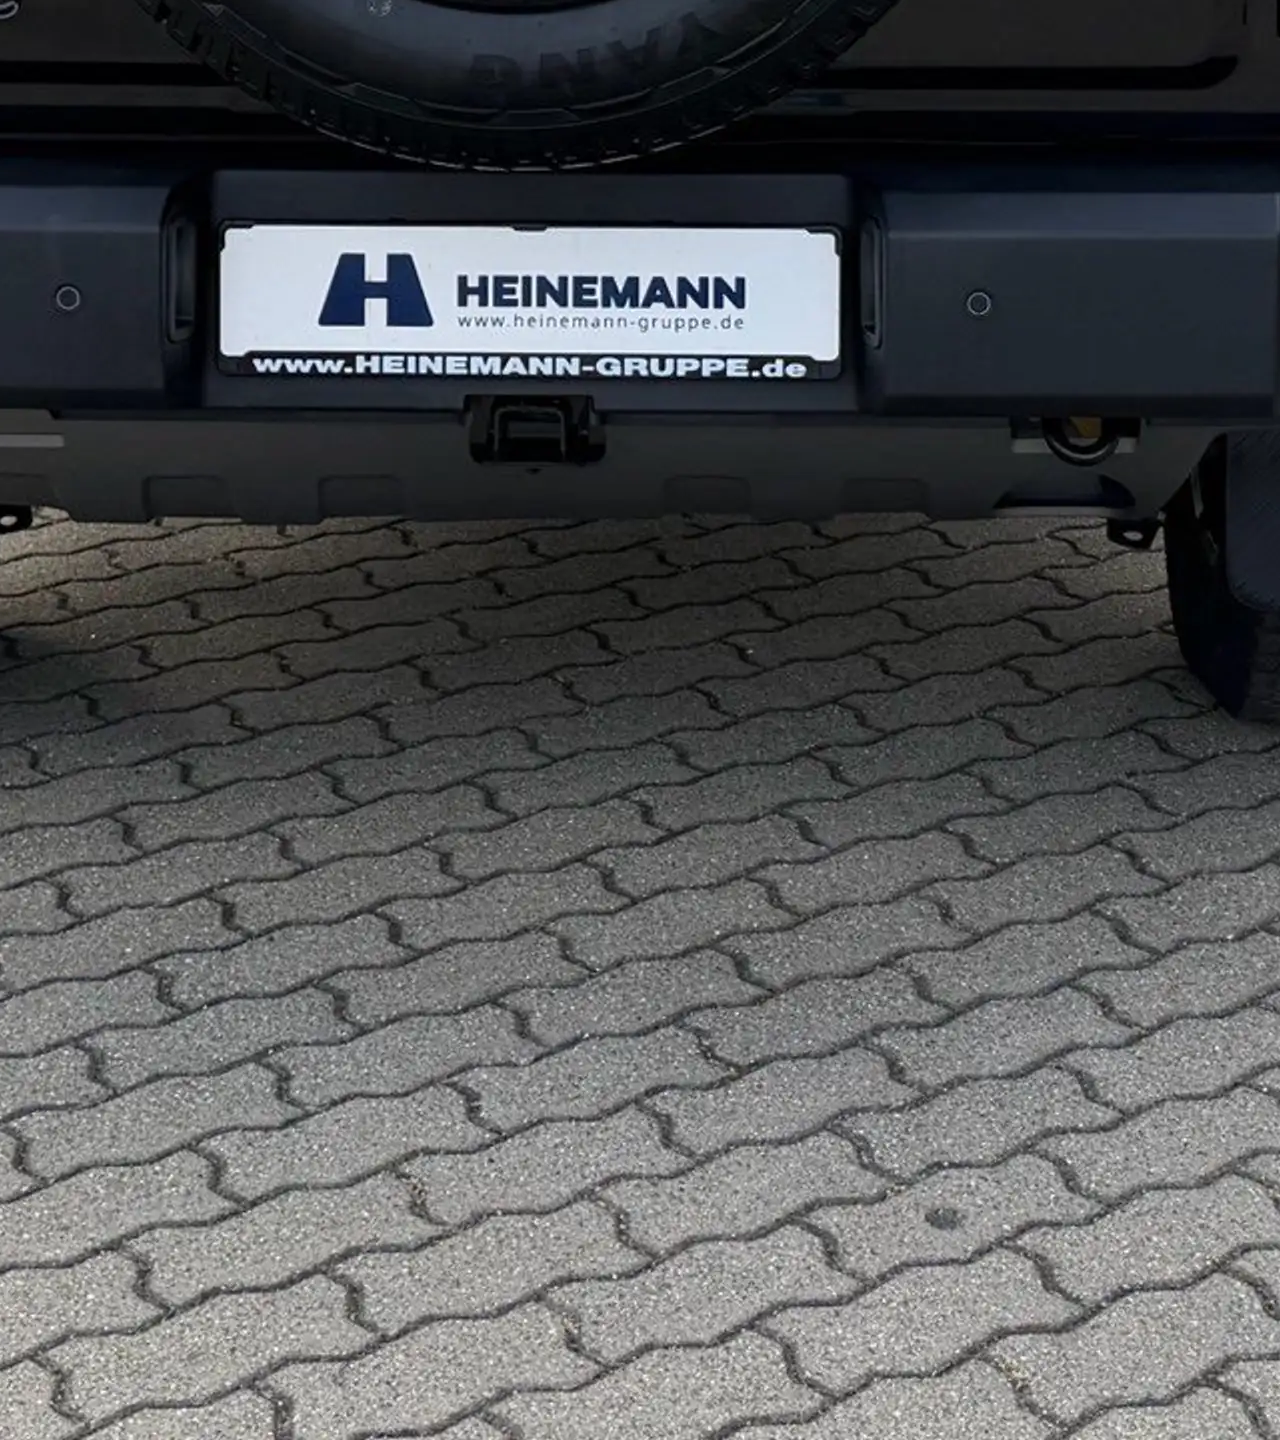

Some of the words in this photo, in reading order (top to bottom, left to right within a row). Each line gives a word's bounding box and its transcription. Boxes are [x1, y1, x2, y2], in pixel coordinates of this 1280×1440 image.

[456, 275, 747, 309] HEINEMANN
[457, 312, 746, 333] www.heinemann-gruppe.de
[252, 355, 808, 380] www.HEINEMANN-GRUPPE.de
